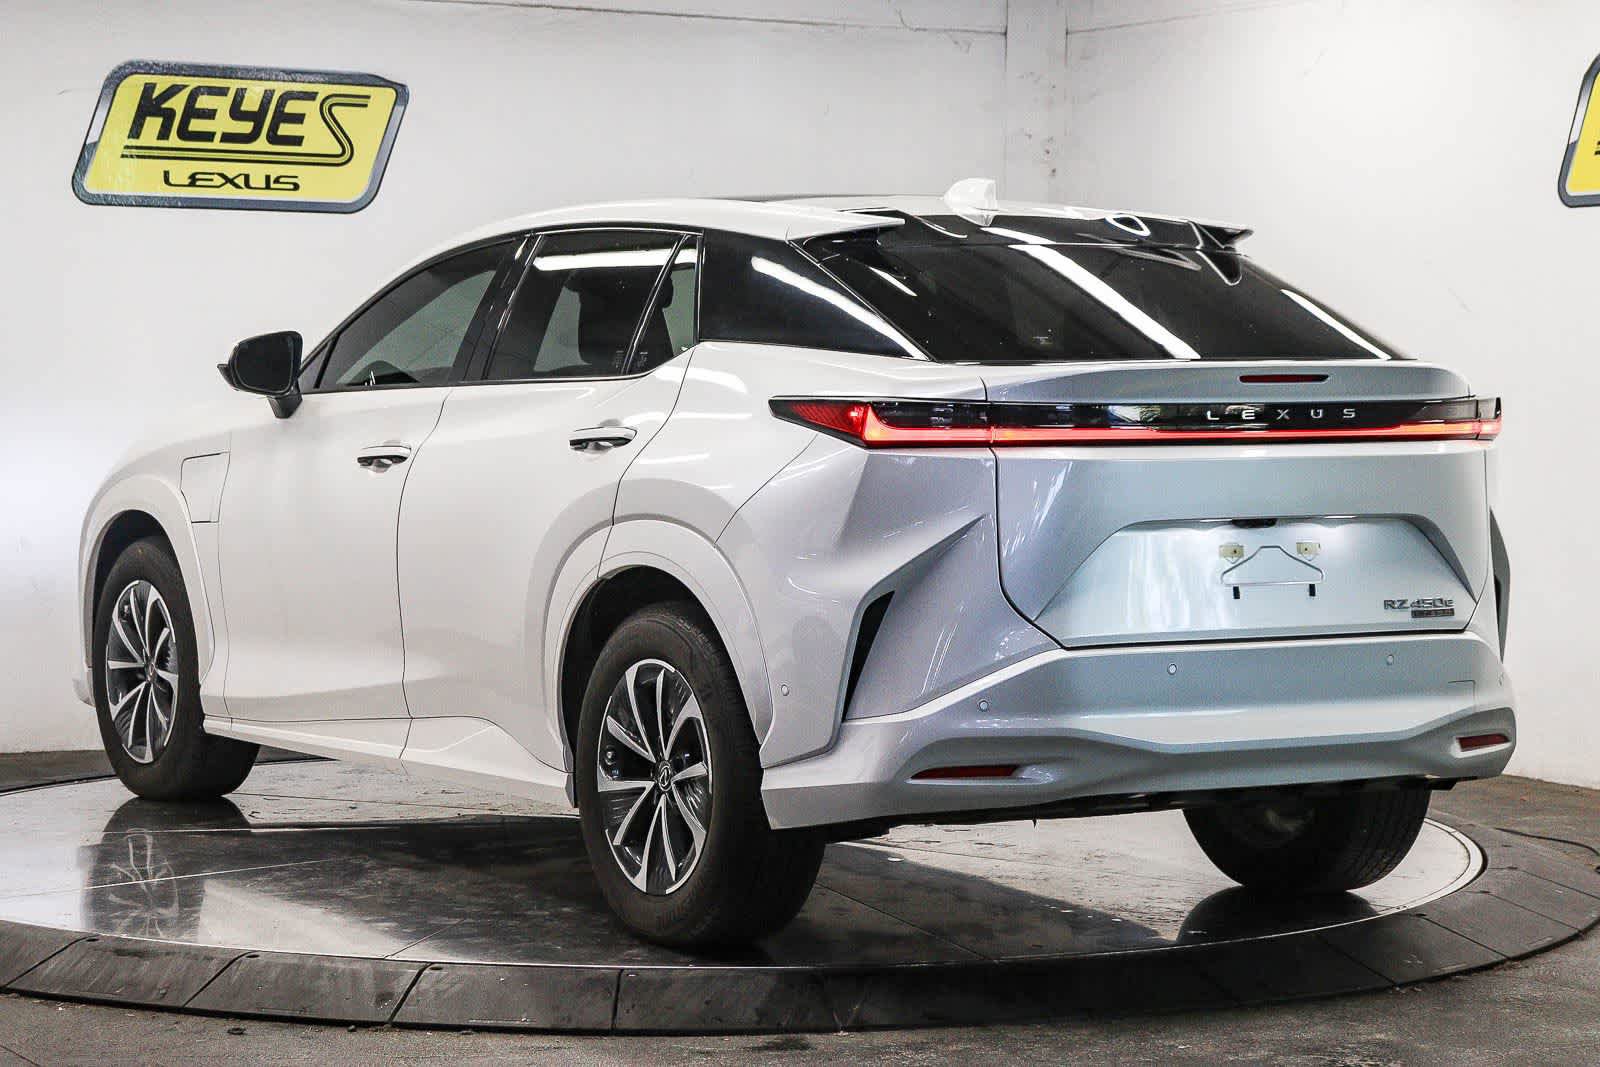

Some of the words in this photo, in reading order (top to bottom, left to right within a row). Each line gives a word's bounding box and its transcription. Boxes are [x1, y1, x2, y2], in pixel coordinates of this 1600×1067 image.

[124, 82, 371, 167] KEYES
[163, 170, 300, 191] LEXUS
[1206, 408, 1356, 421] LEXUS
